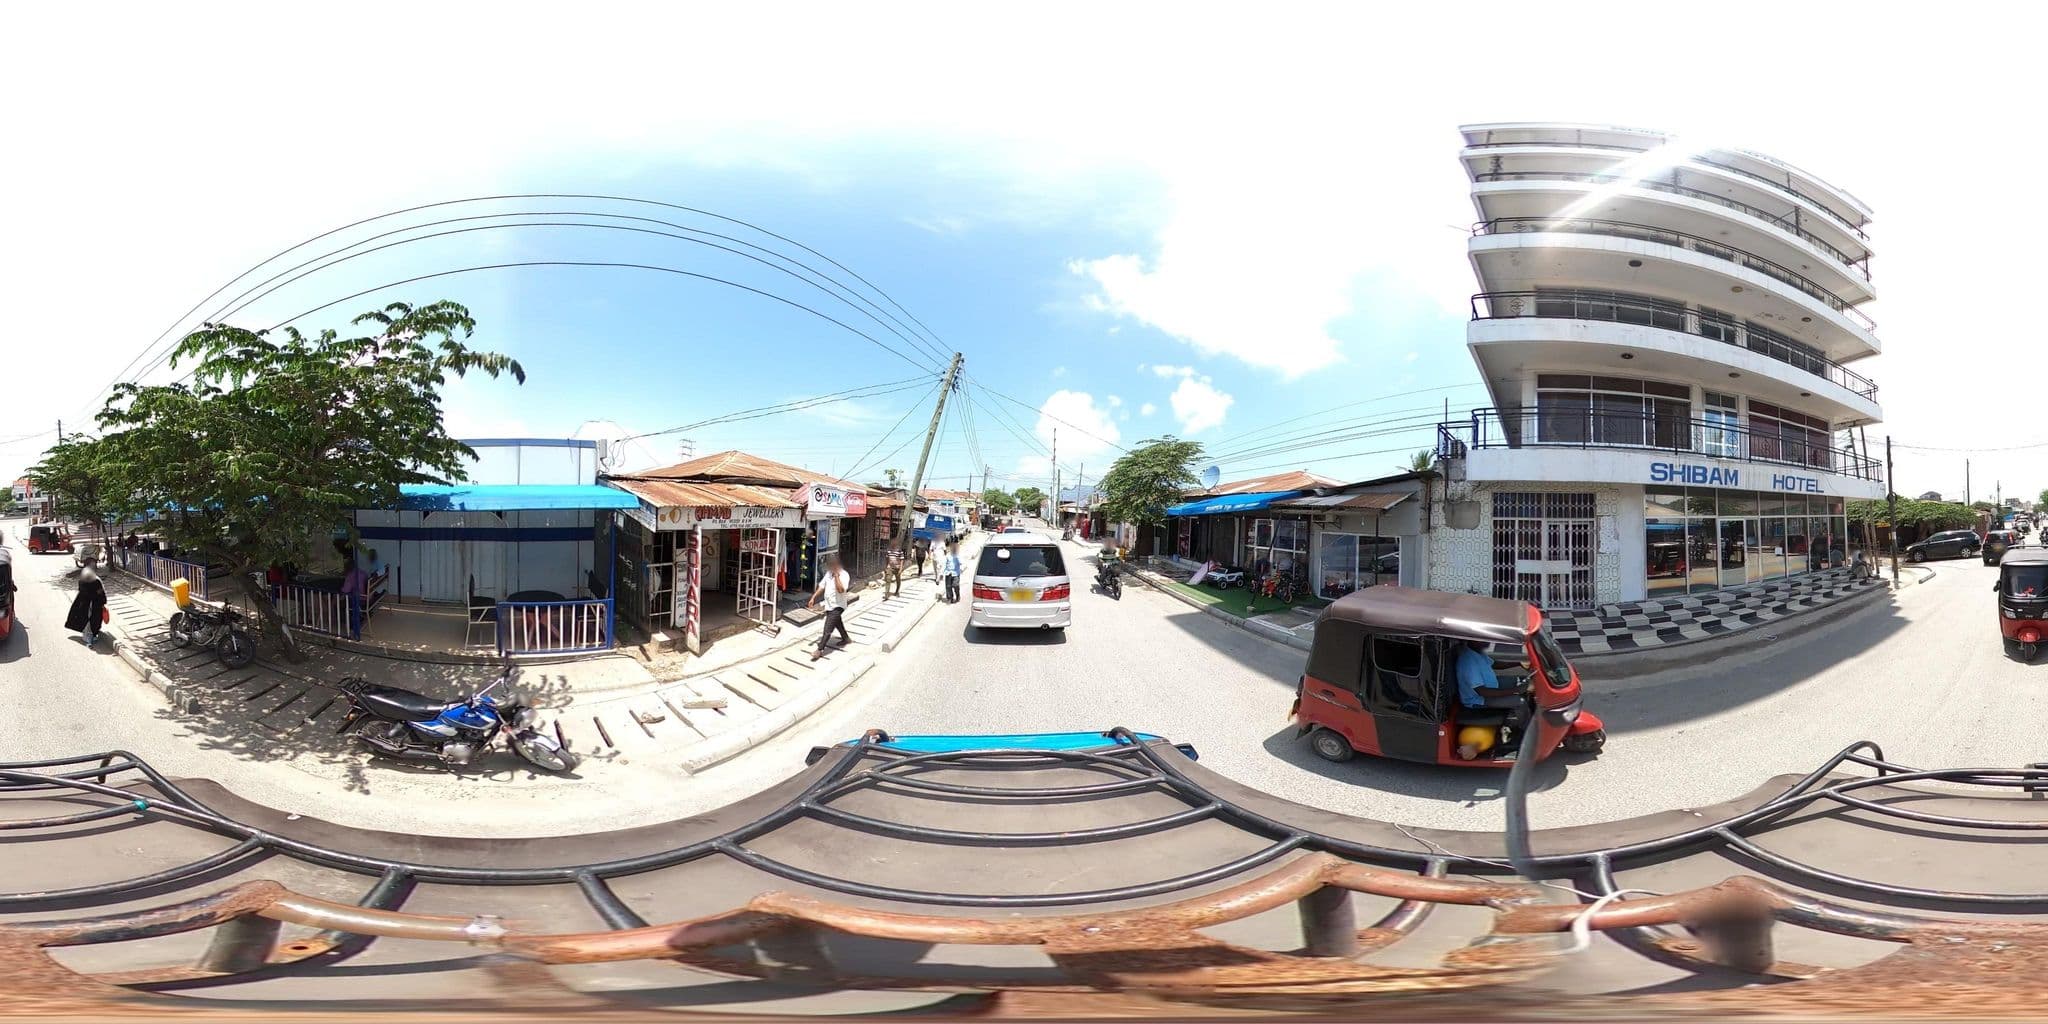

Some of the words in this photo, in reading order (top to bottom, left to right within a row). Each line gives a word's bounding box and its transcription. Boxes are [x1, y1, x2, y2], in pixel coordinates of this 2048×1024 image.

[1650, 462, 1739, 486] SHIBAM
[1773, 473, 1824, 493] HOTEL
[743, 507, 784, 519] JEWELLERS
[686, 529, 698, 638] SONARA
